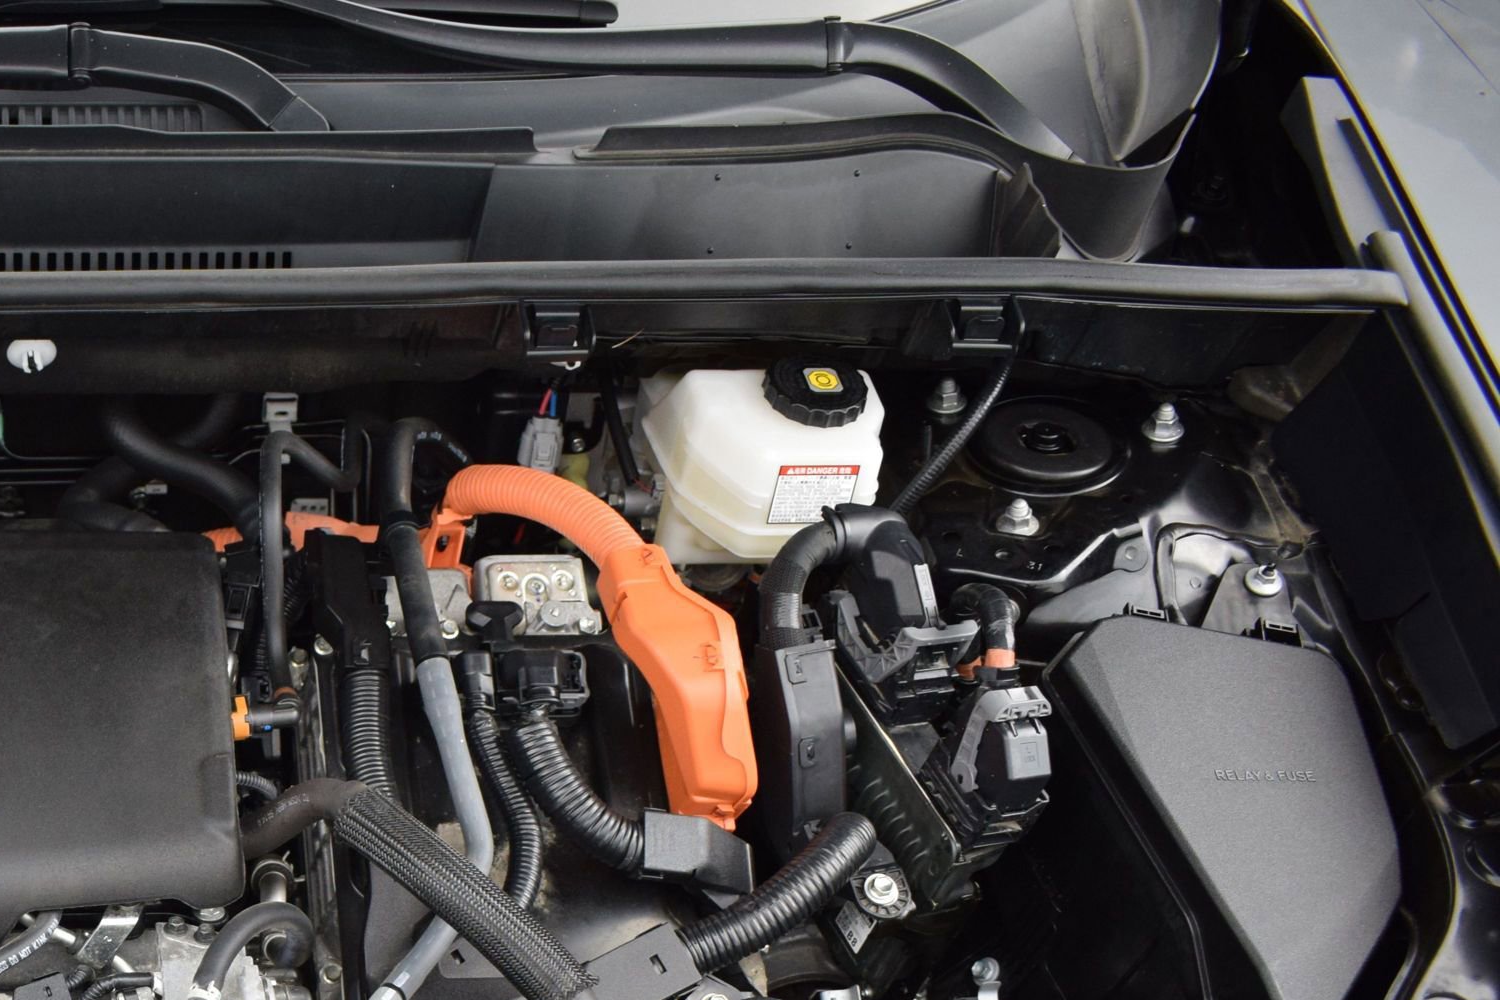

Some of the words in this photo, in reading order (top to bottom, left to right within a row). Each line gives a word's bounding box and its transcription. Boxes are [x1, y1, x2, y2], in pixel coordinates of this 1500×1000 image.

[806, 467, 838, 475] DANGER
[1214, 769, 1261, 781] RELAY
[1277, 769, 1317, 782] FUSE
[18, 946, 32, 960] NOT
